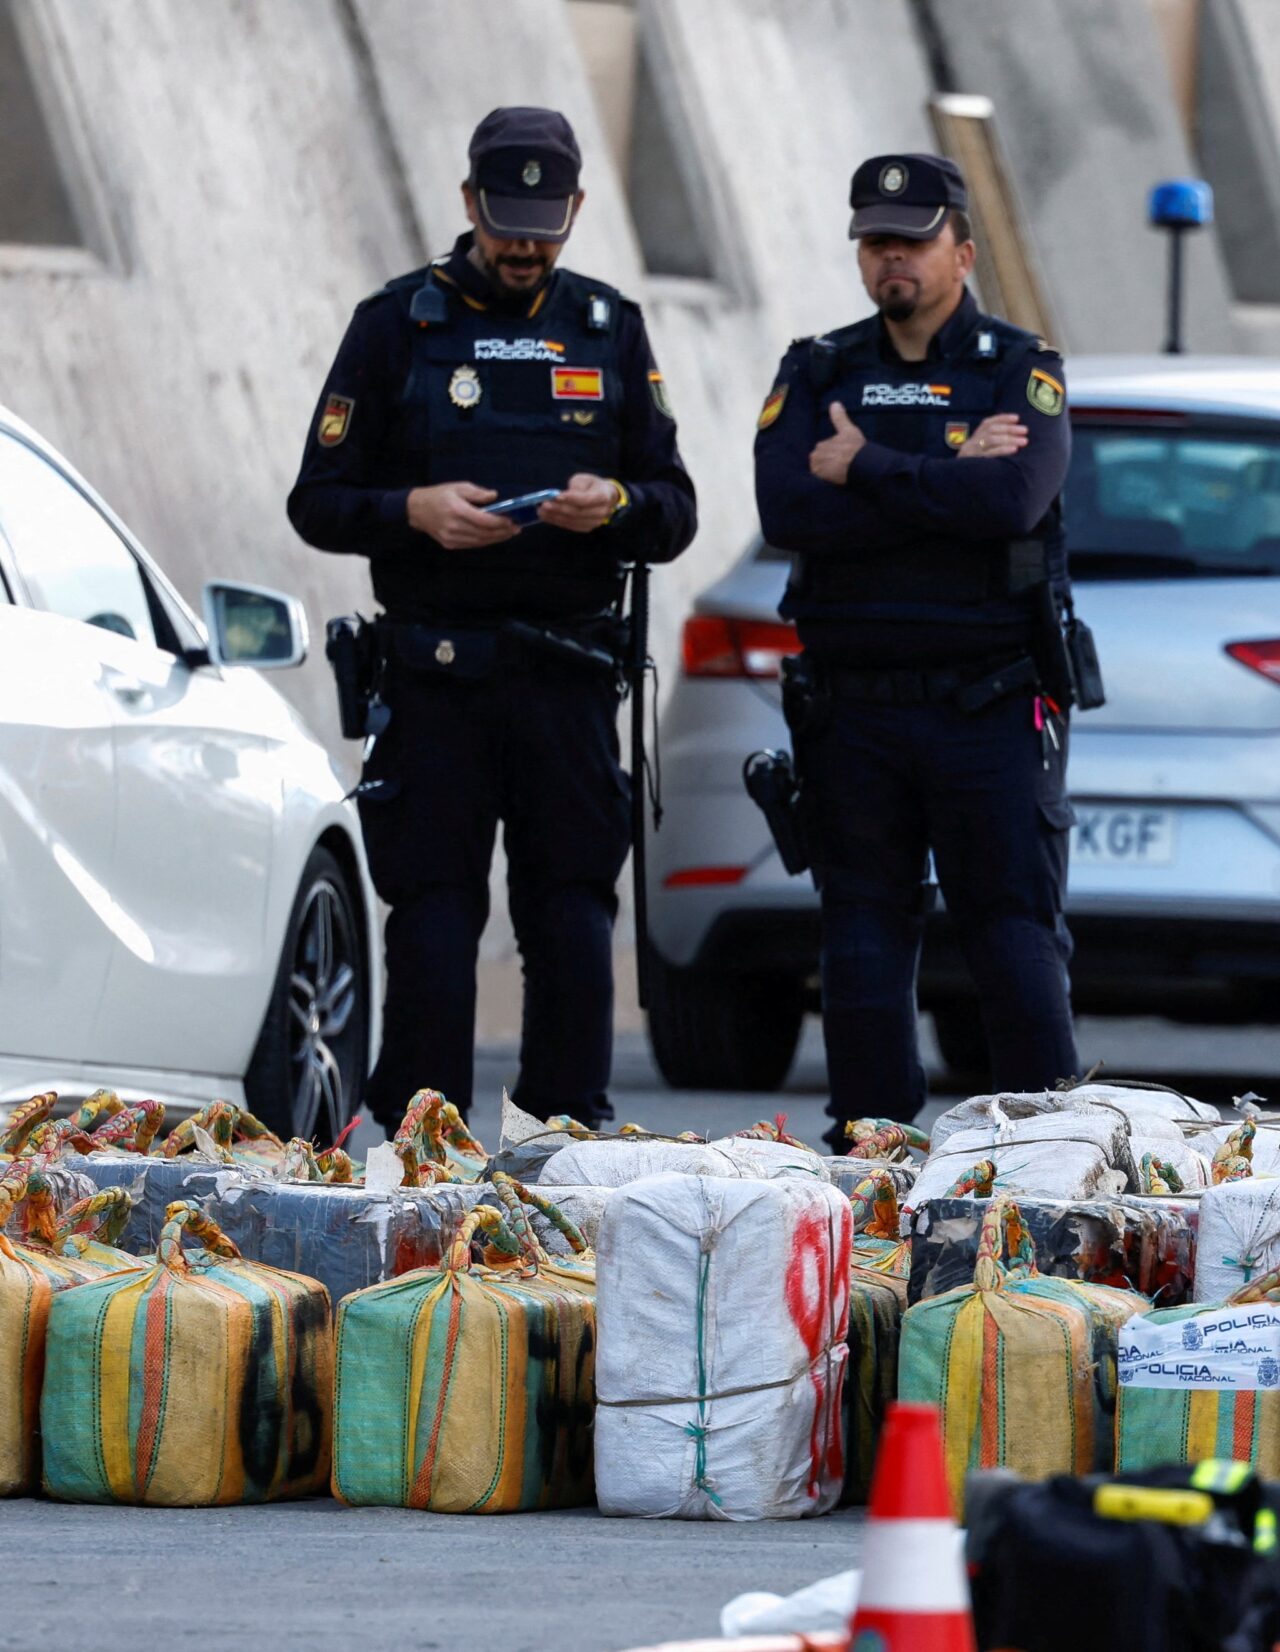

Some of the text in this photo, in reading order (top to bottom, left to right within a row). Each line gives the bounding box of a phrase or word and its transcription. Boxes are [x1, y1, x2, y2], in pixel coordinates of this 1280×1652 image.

[475, 350, 566, 363] NACIONAL
[861, 395, 950, 407] NACIONAL
[1075, 811, 1164, 856] KGF
[1202, 1314, 1280, 1337] POLICIA
[1178, 1374, 1236, 1383] NACIONAL
